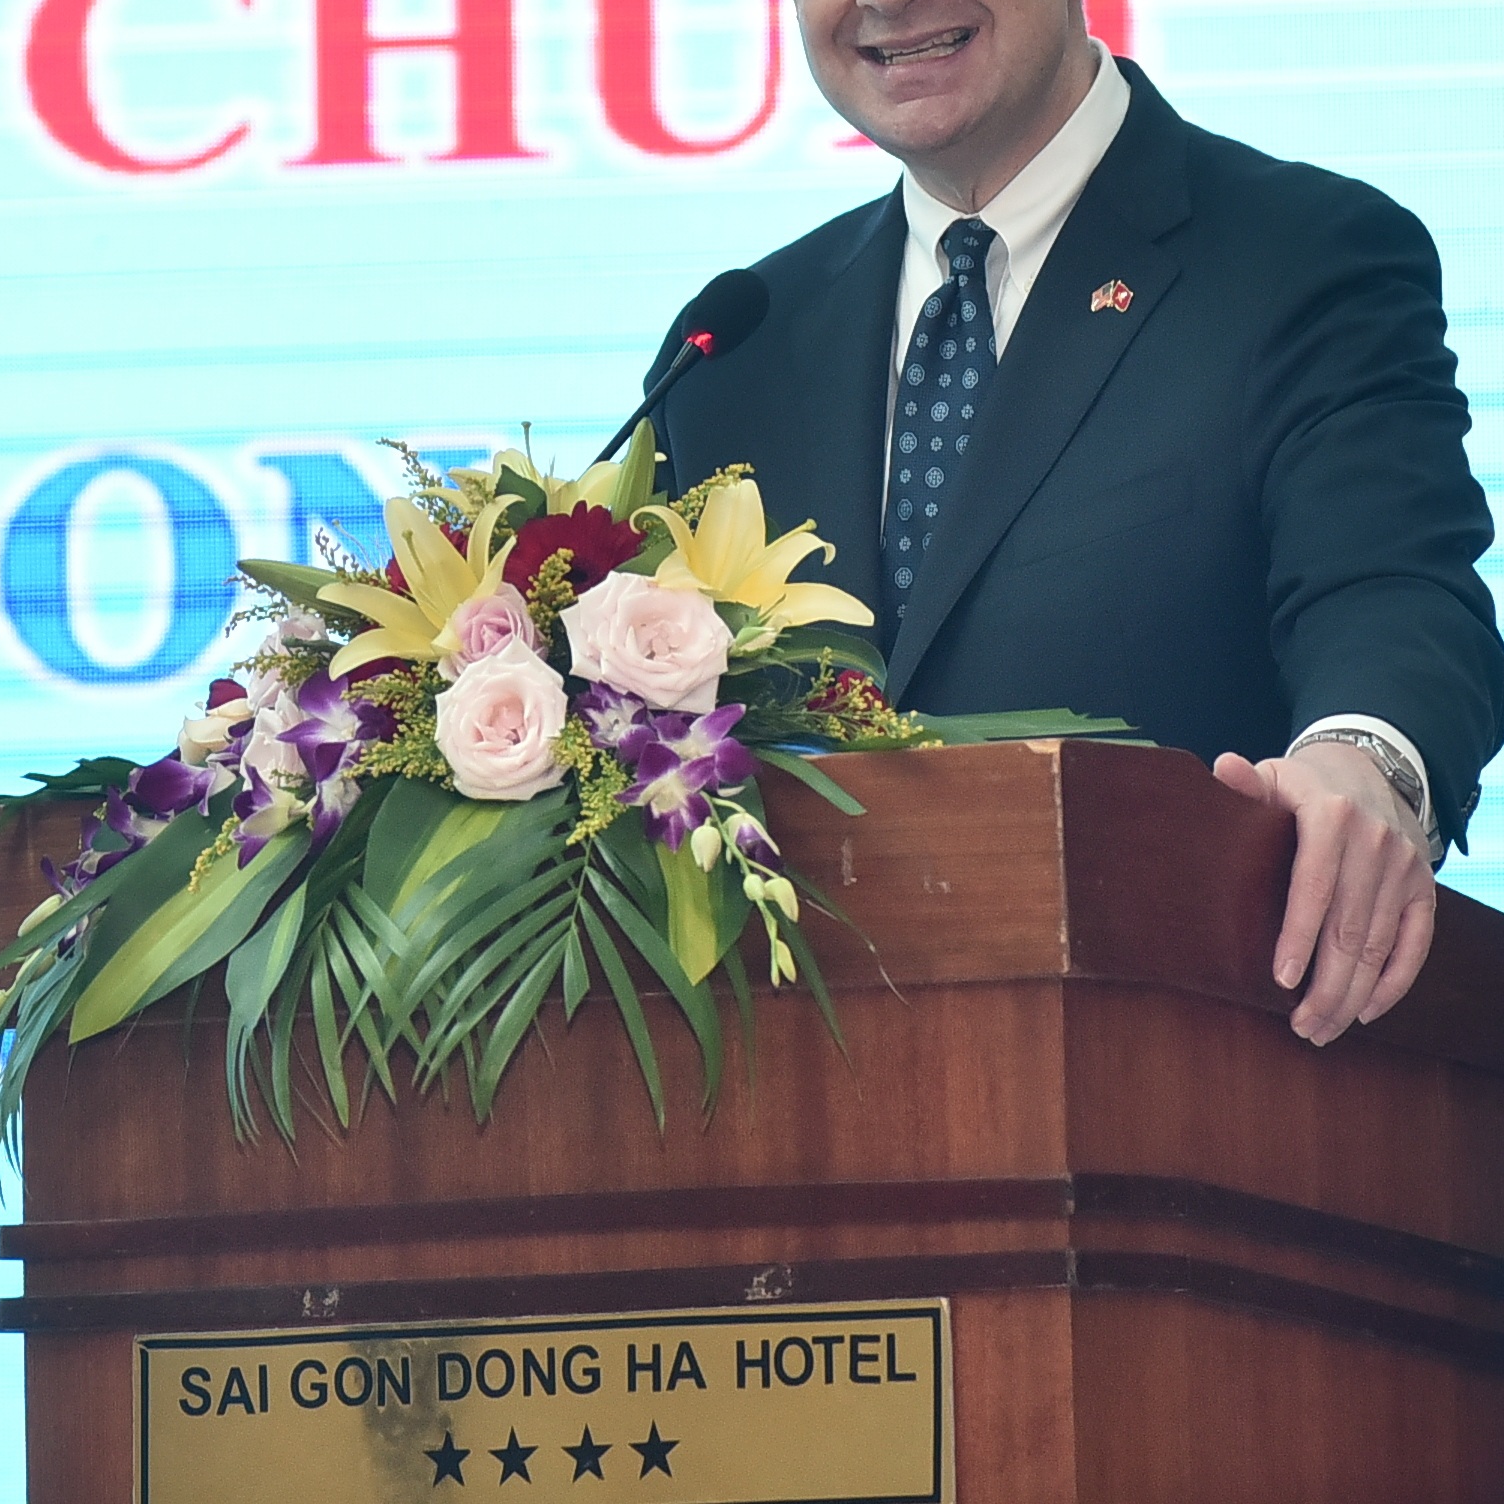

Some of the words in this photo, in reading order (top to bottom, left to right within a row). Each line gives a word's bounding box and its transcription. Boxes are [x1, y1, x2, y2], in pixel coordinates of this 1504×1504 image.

[179, 1364, 270, 1416] SAI
[290, 1356, 411, 1409] GON
[437, 1344, 601, 1402] DONG
[627, 1341, 707, 1393] HA
[736, 1333, 917, 1389] HOTEL
